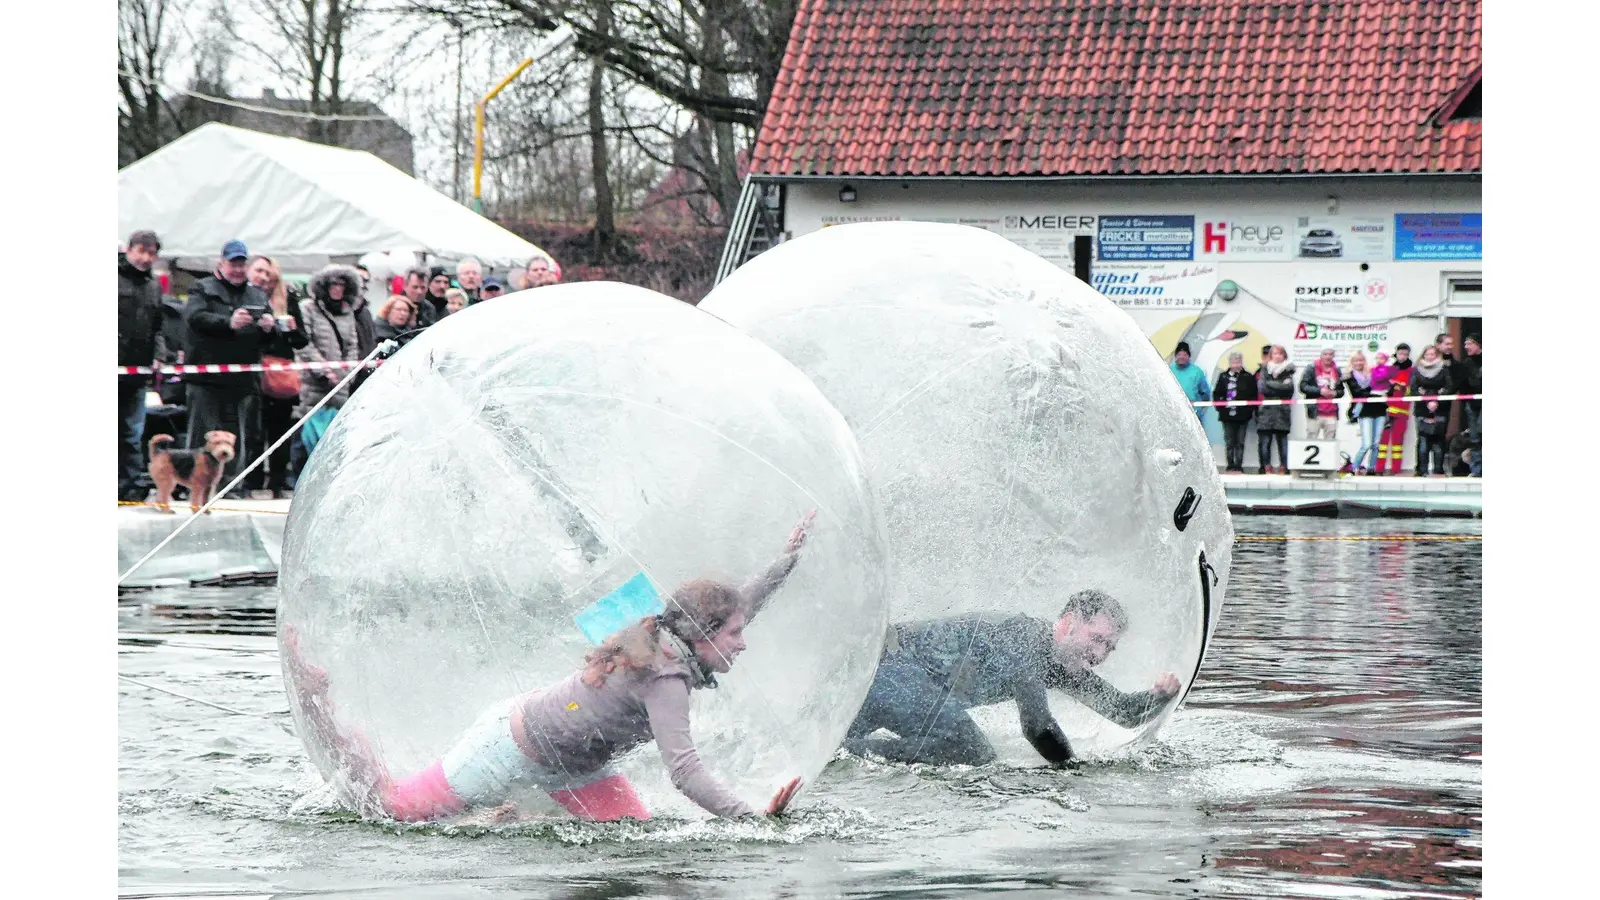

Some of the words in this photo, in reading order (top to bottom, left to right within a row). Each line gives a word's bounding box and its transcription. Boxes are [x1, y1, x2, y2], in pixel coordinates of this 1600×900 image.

[1019, 216, 1095, 229] MEIER
[1100, 229, 1142, 242] FRICKE
[1230, 222, 1284, 245] heye
[1091, 271, 1139, 284] öbel
[1295, 286, 1359, 296] expert
[1320, 332, 1388, 341] ALTENBURG
[1303, 444, 1320, 465] 2
